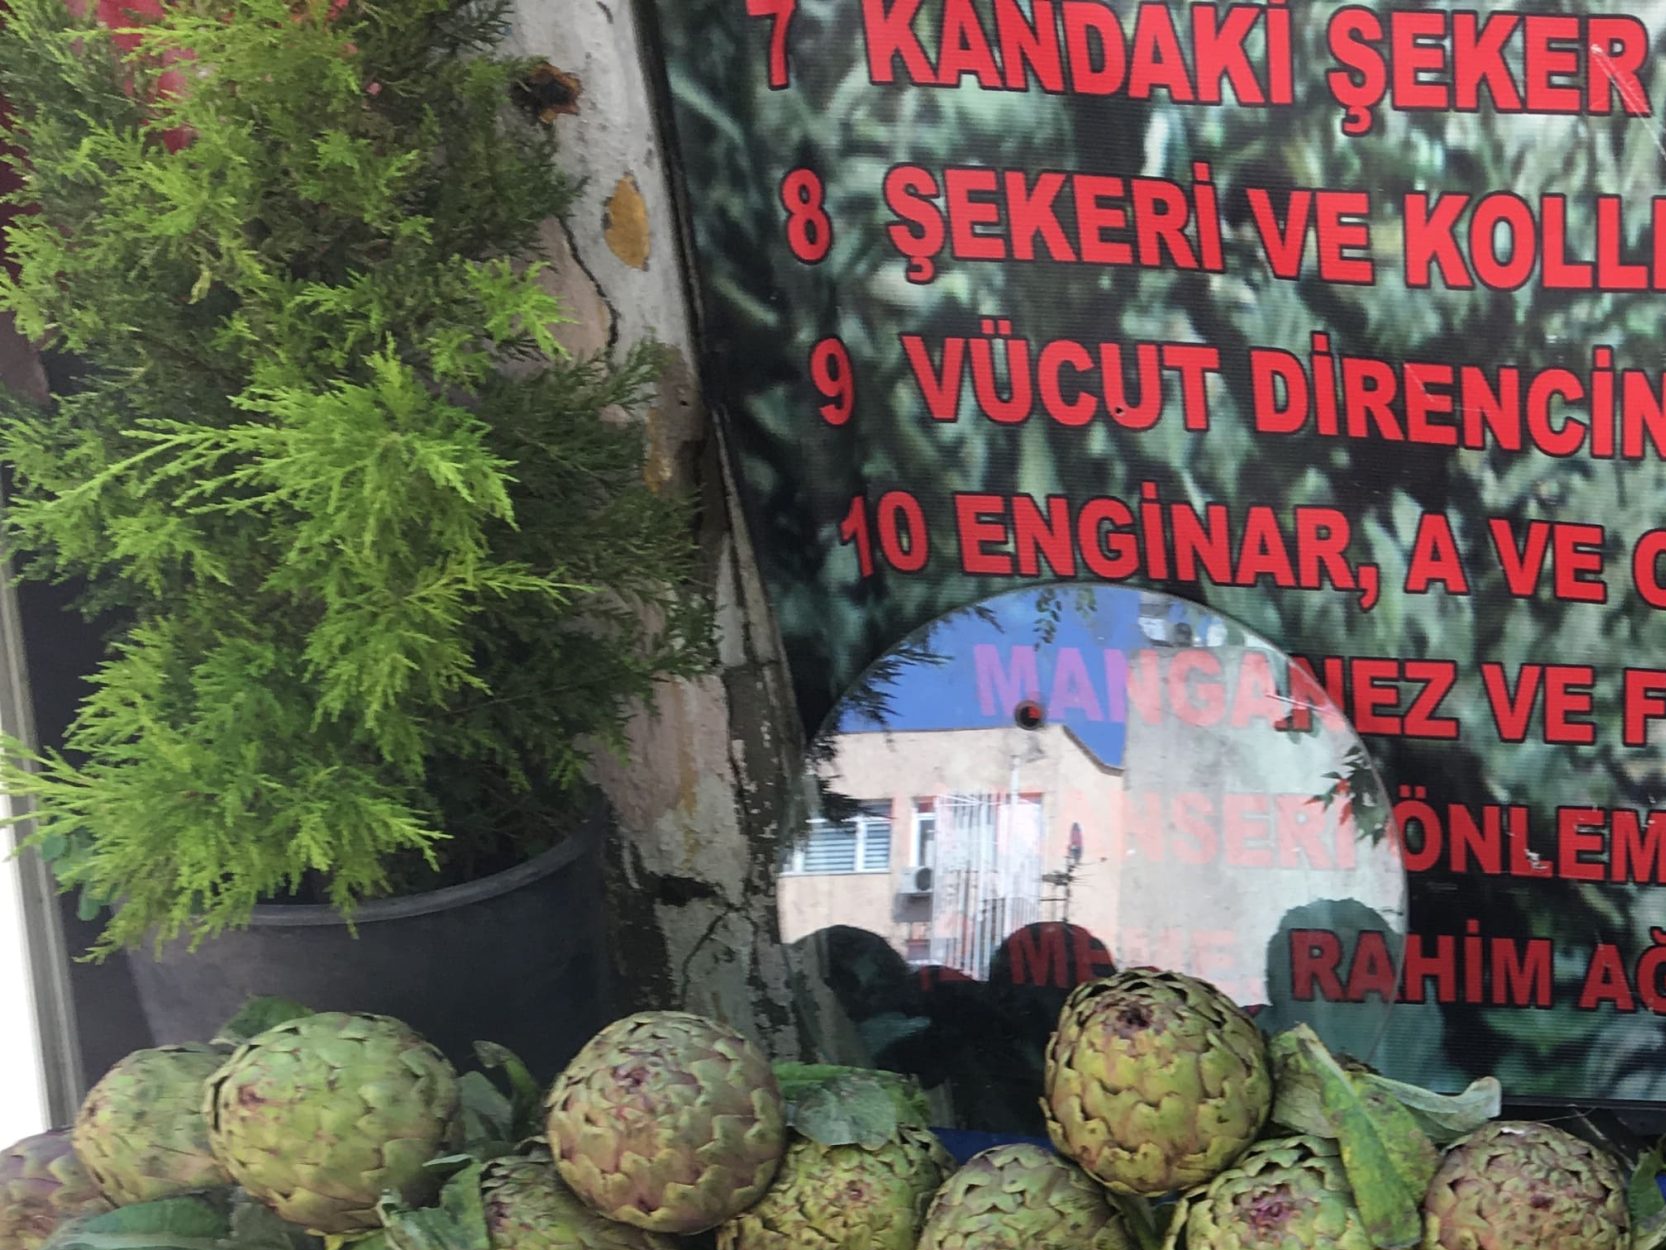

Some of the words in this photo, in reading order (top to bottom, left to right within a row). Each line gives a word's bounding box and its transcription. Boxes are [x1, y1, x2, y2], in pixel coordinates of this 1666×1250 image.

[744, 0, 797, 88] 7
[860, 0, 1295, 107] KANDAKİ
[1326, 6, 1650, 136] ŞEKER
[780, 166, 832, 263] 8
[883, 160, 1226, 283] ŞEKERİ
[1245, 186, 1375, 285] VE
[809, 337, 855, 427] 9
[901, 317, 1222, 432] VÜCUT
[840, 489, 930, 577] 10
[953, 479, 1380, 611] ENGİNAR,
[1404, 511, 1470, 595] A
[1487, 516, 1607, 603] VE
[973, 642, 1460, 740] MANGANEZ
[1480, 661, 1596, 745] VE
[1288, 916, 1553, 1008] RAHİM
